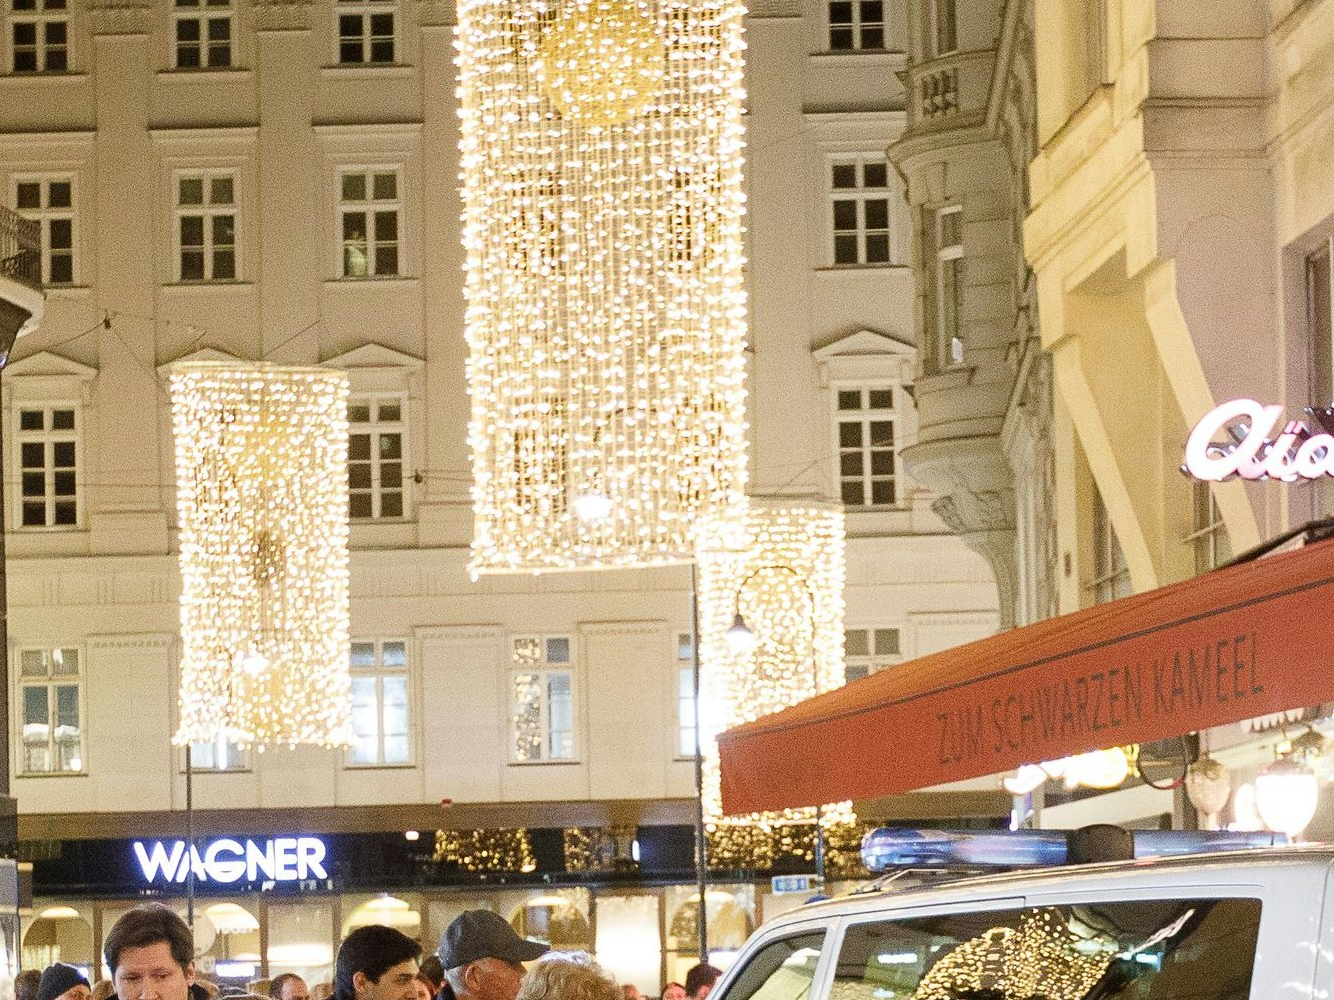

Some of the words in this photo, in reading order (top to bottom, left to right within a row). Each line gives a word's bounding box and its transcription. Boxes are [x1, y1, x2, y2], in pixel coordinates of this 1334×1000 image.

[935, 703, 984, 766] ZUM
[991, 663, 1143, 754] SCHWARZEN
[1153, 631, 1265, 715] KAMEEL
[133, 837, 328, 883] WAGNER
